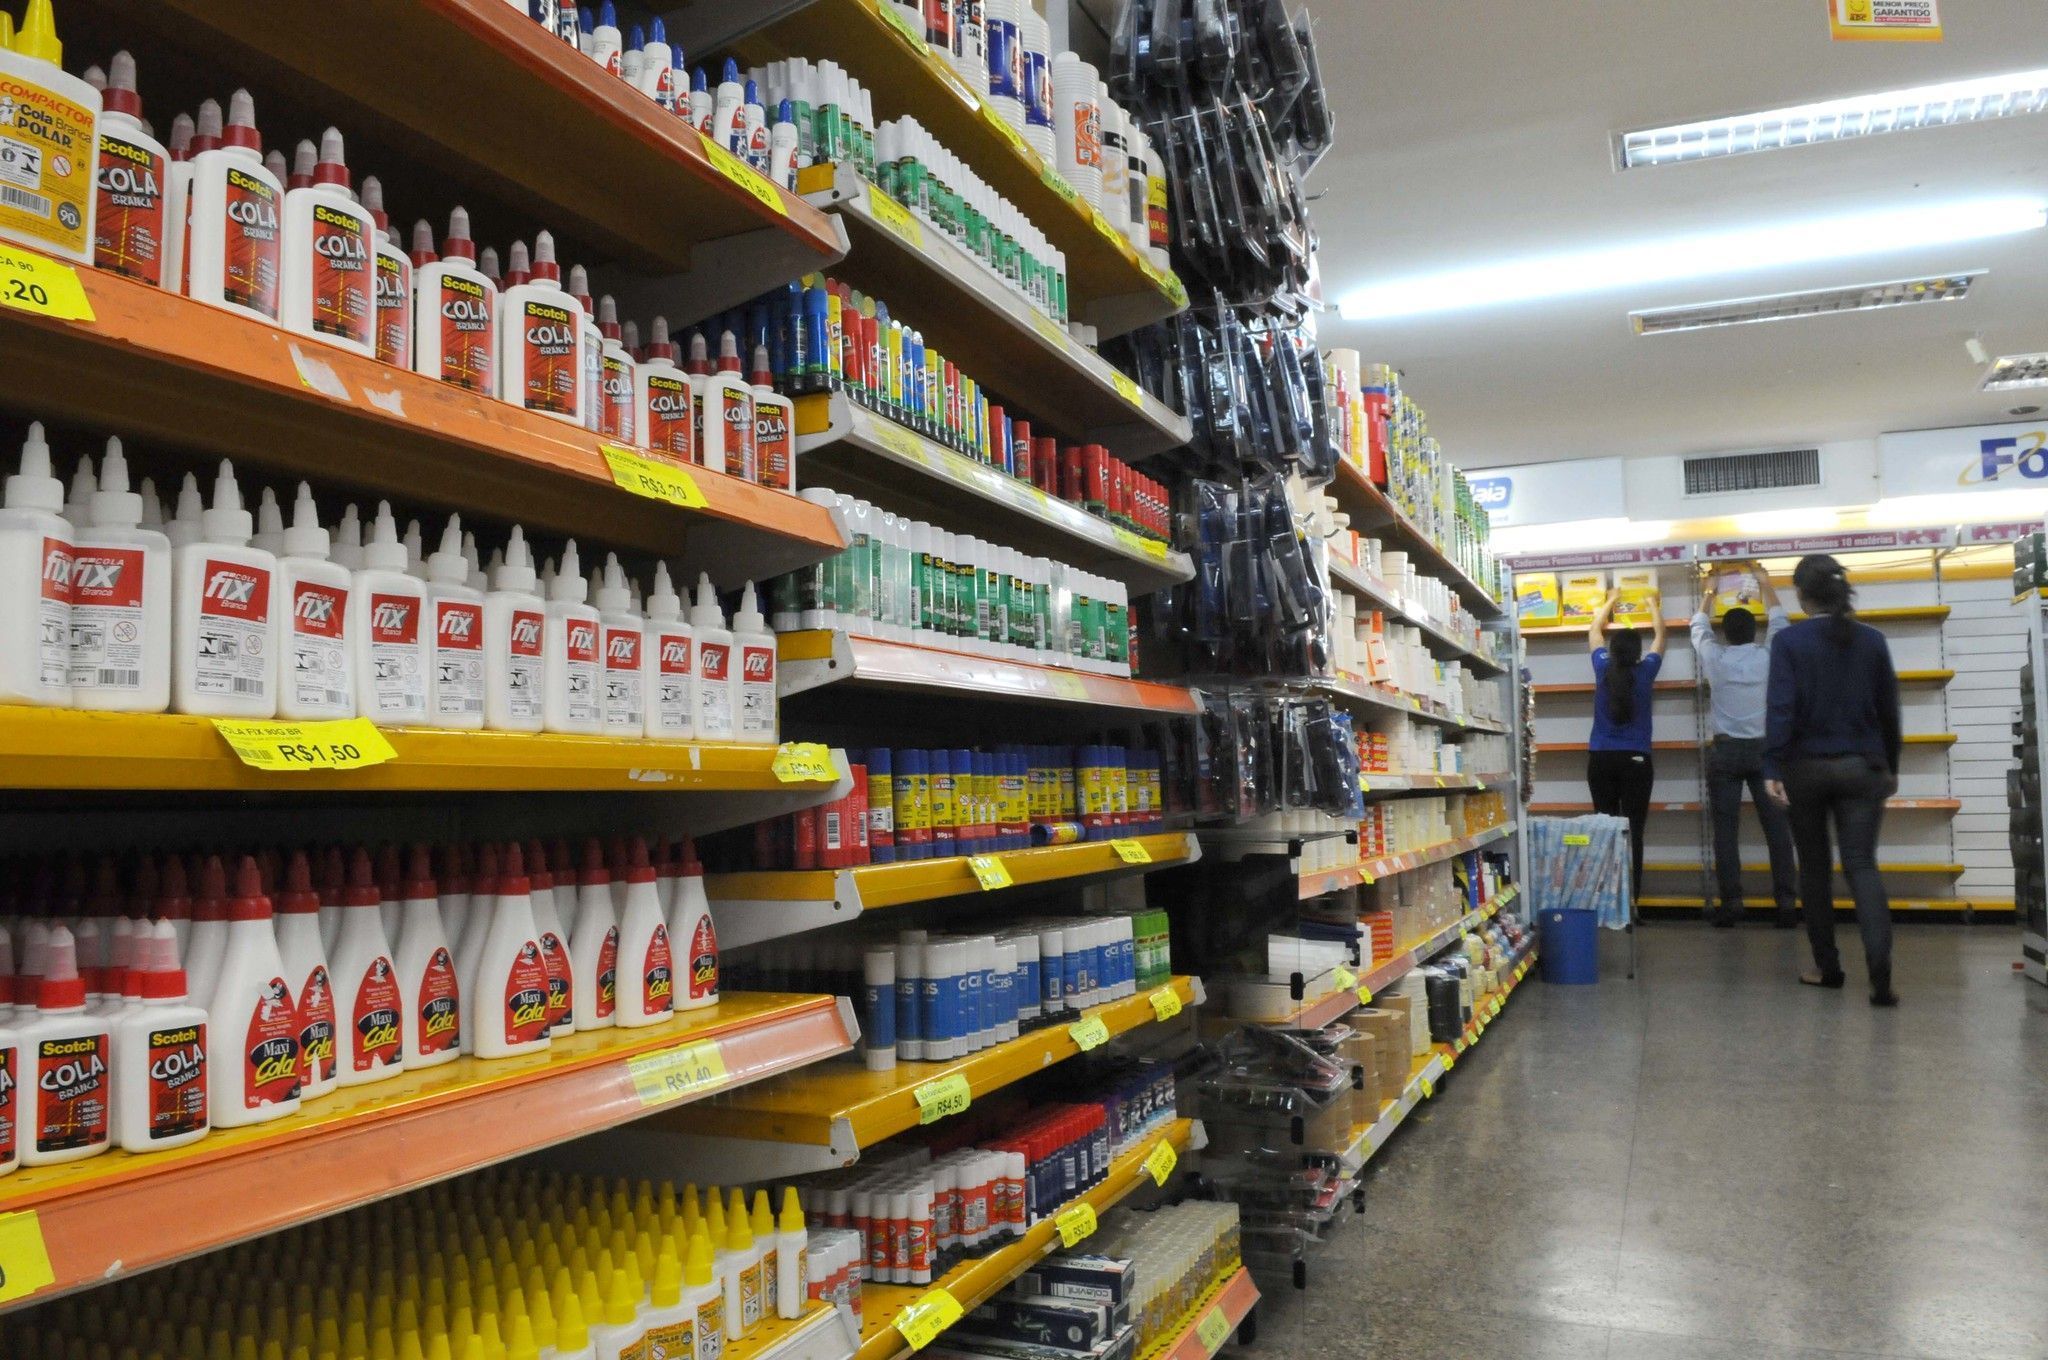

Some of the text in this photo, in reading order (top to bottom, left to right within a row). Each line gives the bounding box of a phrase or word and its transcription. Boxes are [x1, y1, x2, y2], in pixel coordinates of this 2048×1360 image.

[1873, 8, 1930, 16] GARANTIDO
[0, 81, 93, 128] COMPACTOR
[17, 116, 73, 148] POLAR
[20, 104, 92, 144] Cola Branca
[99, 135, 150, 164] Scotch
[230, 171, 273, 198] Scotch
[112, 194, 153, 210] BRANCA
[228, 200, 278, 230] COLA
[316, 206, 360, 232] Scotch
[244, 226, 274, 241] BRANCA
[314, 235, 367, 260] COLA
[18, 260, 34, 274] 90
[330, 258, 364, 272] BRANCA
[376, 256, 400, 273] otch
[376, 276, 405, 297] OLA
[442, 276, 484, 296] Scotch
[376, 298, 403, 308] RANCA
[441, 300, 490, 320] COLA
[527, 304, 568, 322] Scotch
[456, 321, 486, 332] BRANCA
[526, 326, 574, 346] COLA
[540, 346, 570, 355] BRANCA
[650, 378, 682, 391] Scotch
[650, 396, 688, 412] COLA
[756, 406, 780, 415] cotch
[756, 420, 787, 434] OLA
[1470, 482, 1506, 503] aia
[1752, 540, 1792, 552] Cadernos
[1794, 538, 1839, 549] Femininos
[1854, 535, 1894, 546] matérias
[96, 558, 124, 566] COLA
[72, 557, 124, 588] fix
[82, 587, 114, 596] Branca
[205, 570, 255, 603] fix
[295, 592, 332, 622] fix
[372, 602, 408, 630] fix
[439, 610, 472, 636] fix
[512, 618, 540, 643] fix
[568, 626, 594, 650] fix
[608, 636, 635, 658] fix
[662, 642, 686, 662] fix
[702, 649, 721, 670] fix
[745, 652, 768, 672] fix
[278, 744, 361, 764] R$1,50
[696, 965, 716, 984] Cola
[520, 992, 540, 1004] Maxi
[649, 978, 670, 999] Cola
[432, 1000, 451, 1014] Maxi
[513, 1002, 546, 1024] Cola
[370, 1014, 392, 1026] Maxi
[426, 1010, 455, 1034] Cola
[152, 1029, 196, 1046] Scotch
[310, 1024, 328, 1040] Maxi
[364, 1024, 398, 1049] Cola
[43, 1040, 96, 1056] Scotch
[264, 1040, 290, 1058] Maxi
[304, 1037, 332, 1062] Cola
[151, 1044, 204, 1079] COLA
[256, 1054, 296, 1083] Cola
[40, 1054, 105, 1090] COLA
[168, 1067, 200, 1088] BRANCA
[58, 1079, 99, 1100] BRANCA
